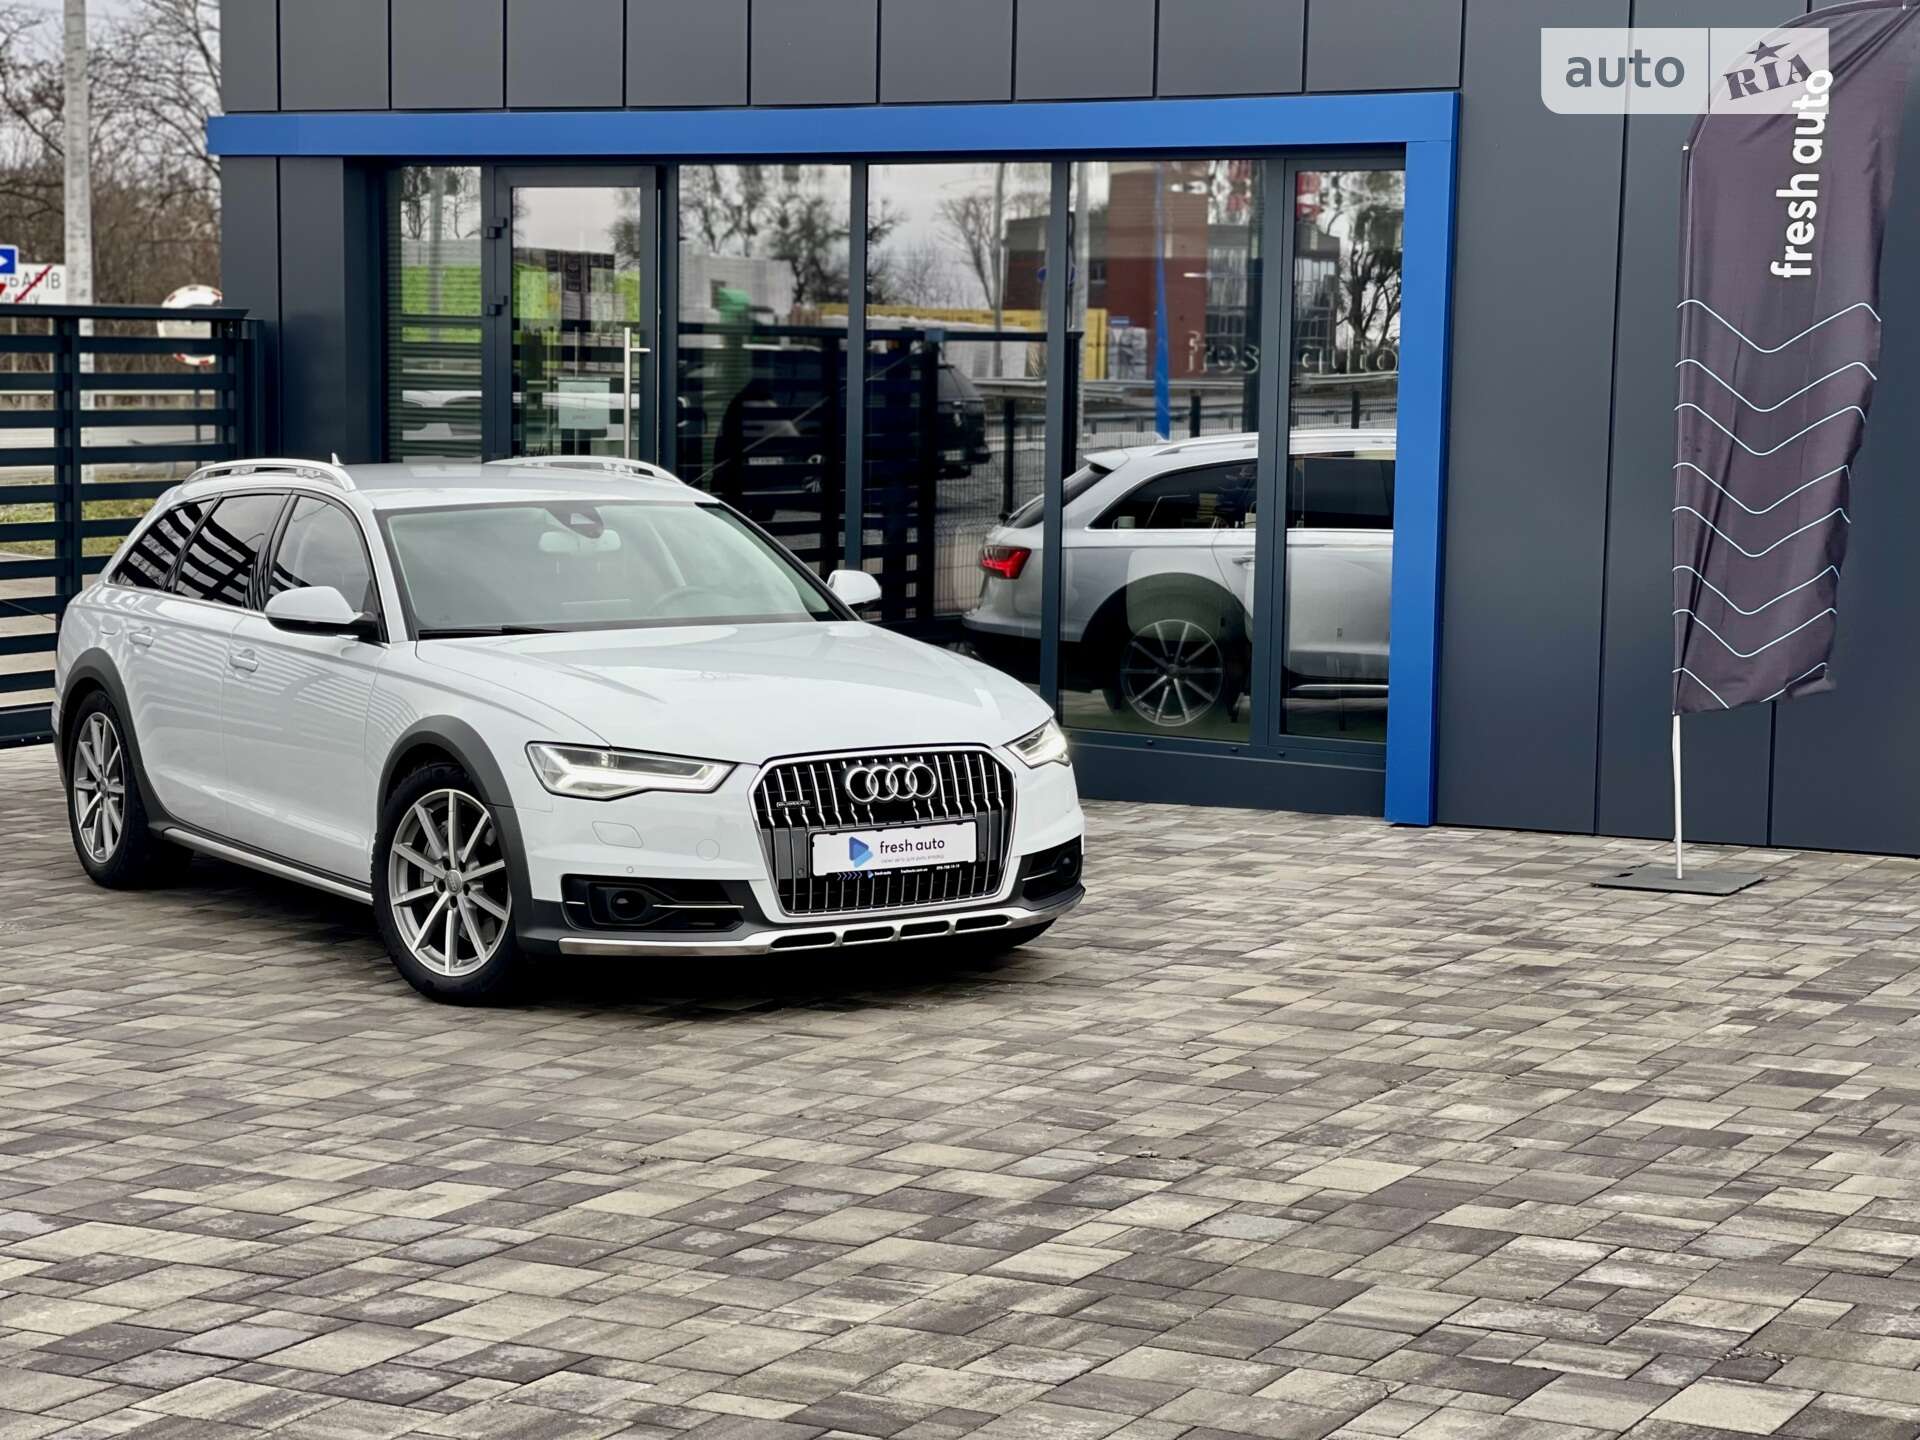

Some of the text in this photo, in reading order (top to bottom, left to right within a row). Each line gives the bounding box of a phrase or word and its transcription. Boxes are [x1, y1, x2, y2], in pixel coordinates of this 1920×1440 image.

[1770, 69, 1834, 278] fresh auto
[880, 837, 945, 854] fresh auto
